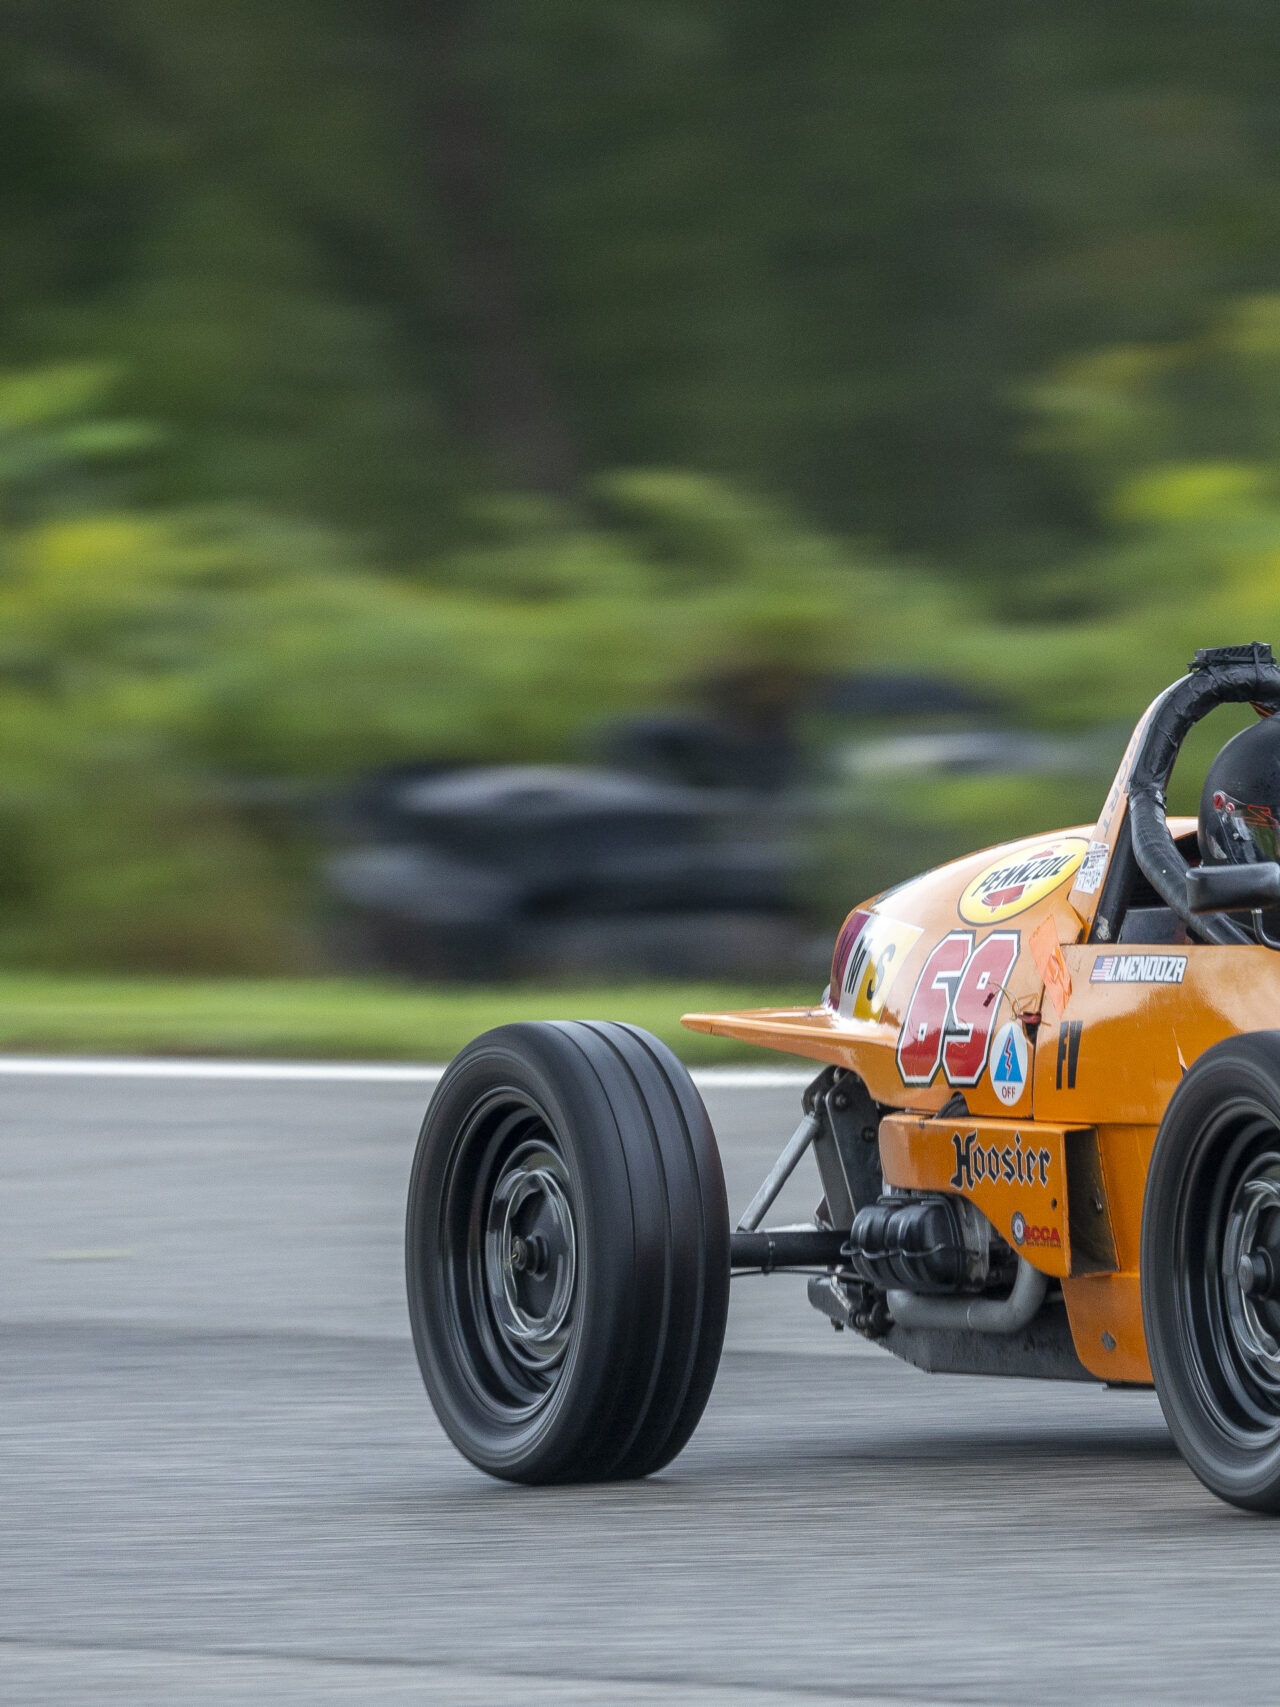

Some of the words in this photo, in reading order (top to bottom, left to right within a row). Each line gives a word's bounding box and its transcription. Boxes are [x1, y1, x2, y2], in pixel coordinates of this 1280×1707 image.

[971, 853, 1077, 898] PENNZOIL
[896, 929, 1021, 1089] 69
[1001, 1085, 1017, 1099] OFF
[950, 1128, 1052, 1191] Hoosier
[1023, 1225, 1062, 1242] SCCA
